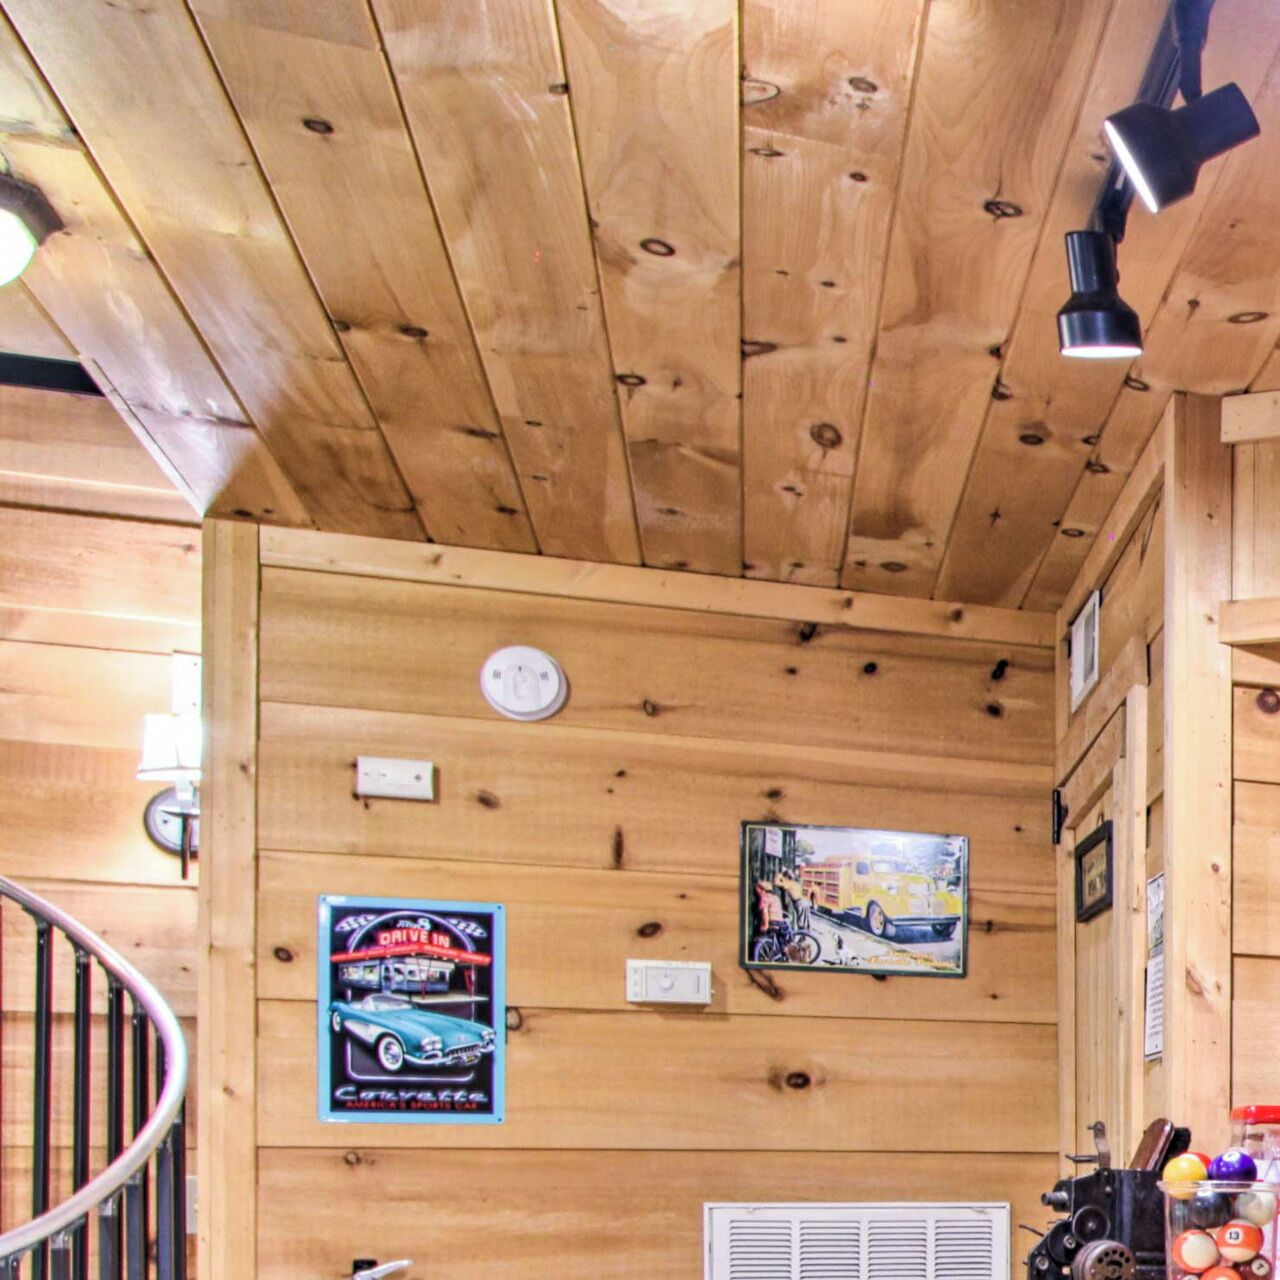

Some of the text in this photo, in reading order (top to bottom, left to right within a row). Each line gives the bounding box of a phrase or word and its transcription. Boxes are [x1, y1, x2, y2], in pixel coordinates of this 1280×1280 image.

[380, 930, 450, 948] DRIVE IN
[335, 1086, 488, 1103] Corvette
[1228, 1231, 1240, 1241] 13
